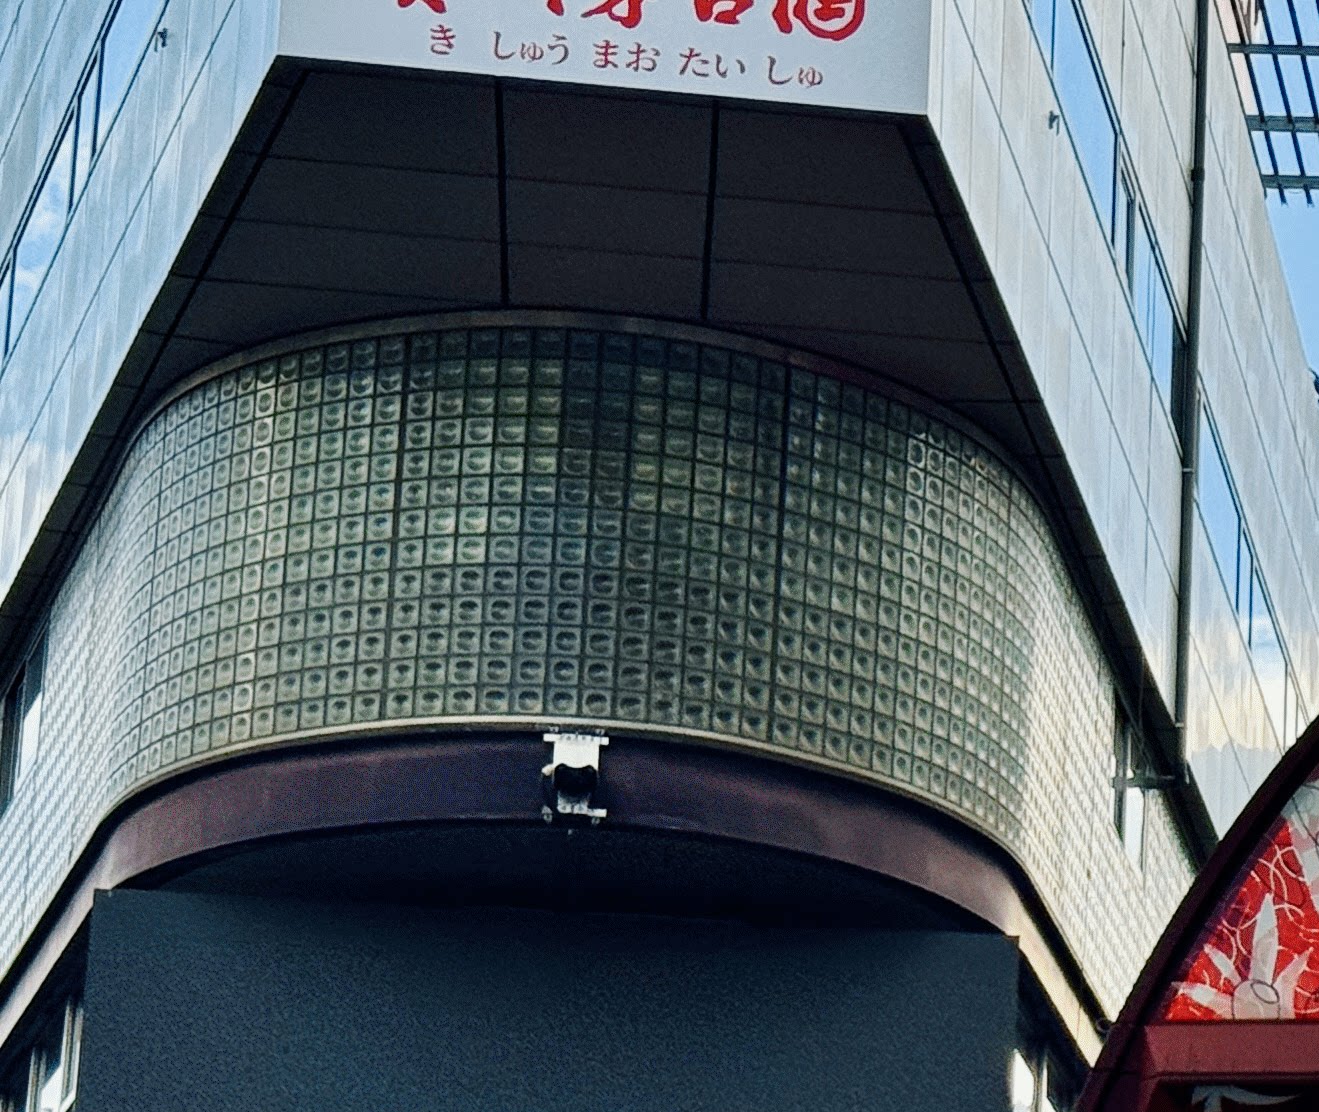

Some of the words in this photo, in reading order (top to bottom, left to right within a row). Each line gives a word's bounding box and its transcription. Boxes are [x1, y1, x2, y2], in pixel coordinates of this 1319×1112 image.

[429, 24, 457, 56] き
[492, 30, 570, 65] しゅう
[592, 39, 660, 73] まお
[678, 46, 747, 79] たい
[766, 55, 824, 89] しゅ
